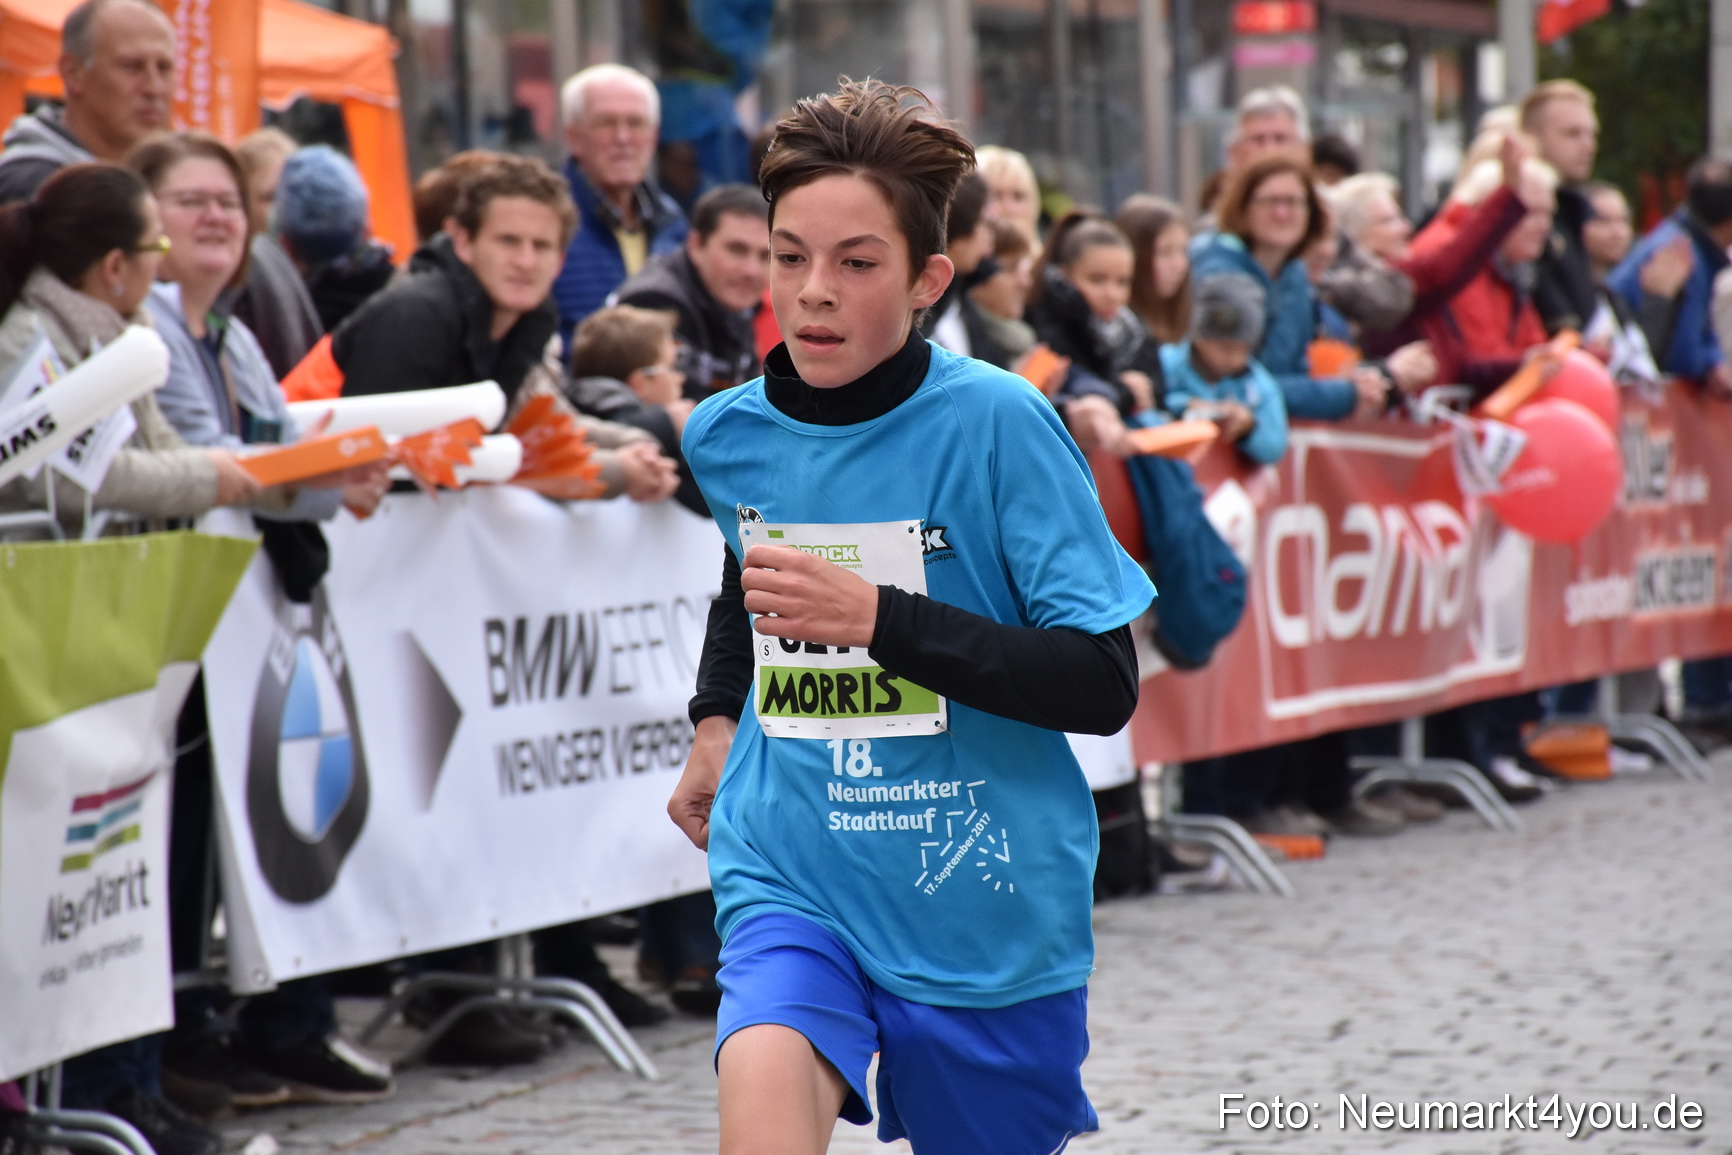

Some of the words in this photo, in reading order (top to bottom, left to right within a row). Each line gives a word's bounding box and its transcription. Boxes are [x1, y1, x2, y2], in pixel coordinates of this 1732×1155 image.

[761, 670, 903, 715] MORRIS
[826, 738, 883, 778] 18.
[827, 779, 962, 803] Neumarkter
[828, 807, 937, 834] Stadtlauf
[923, 881, 939, 896] 17.
[933, 834, 976, 885] September
[970, 812, 992, 838] 2017
